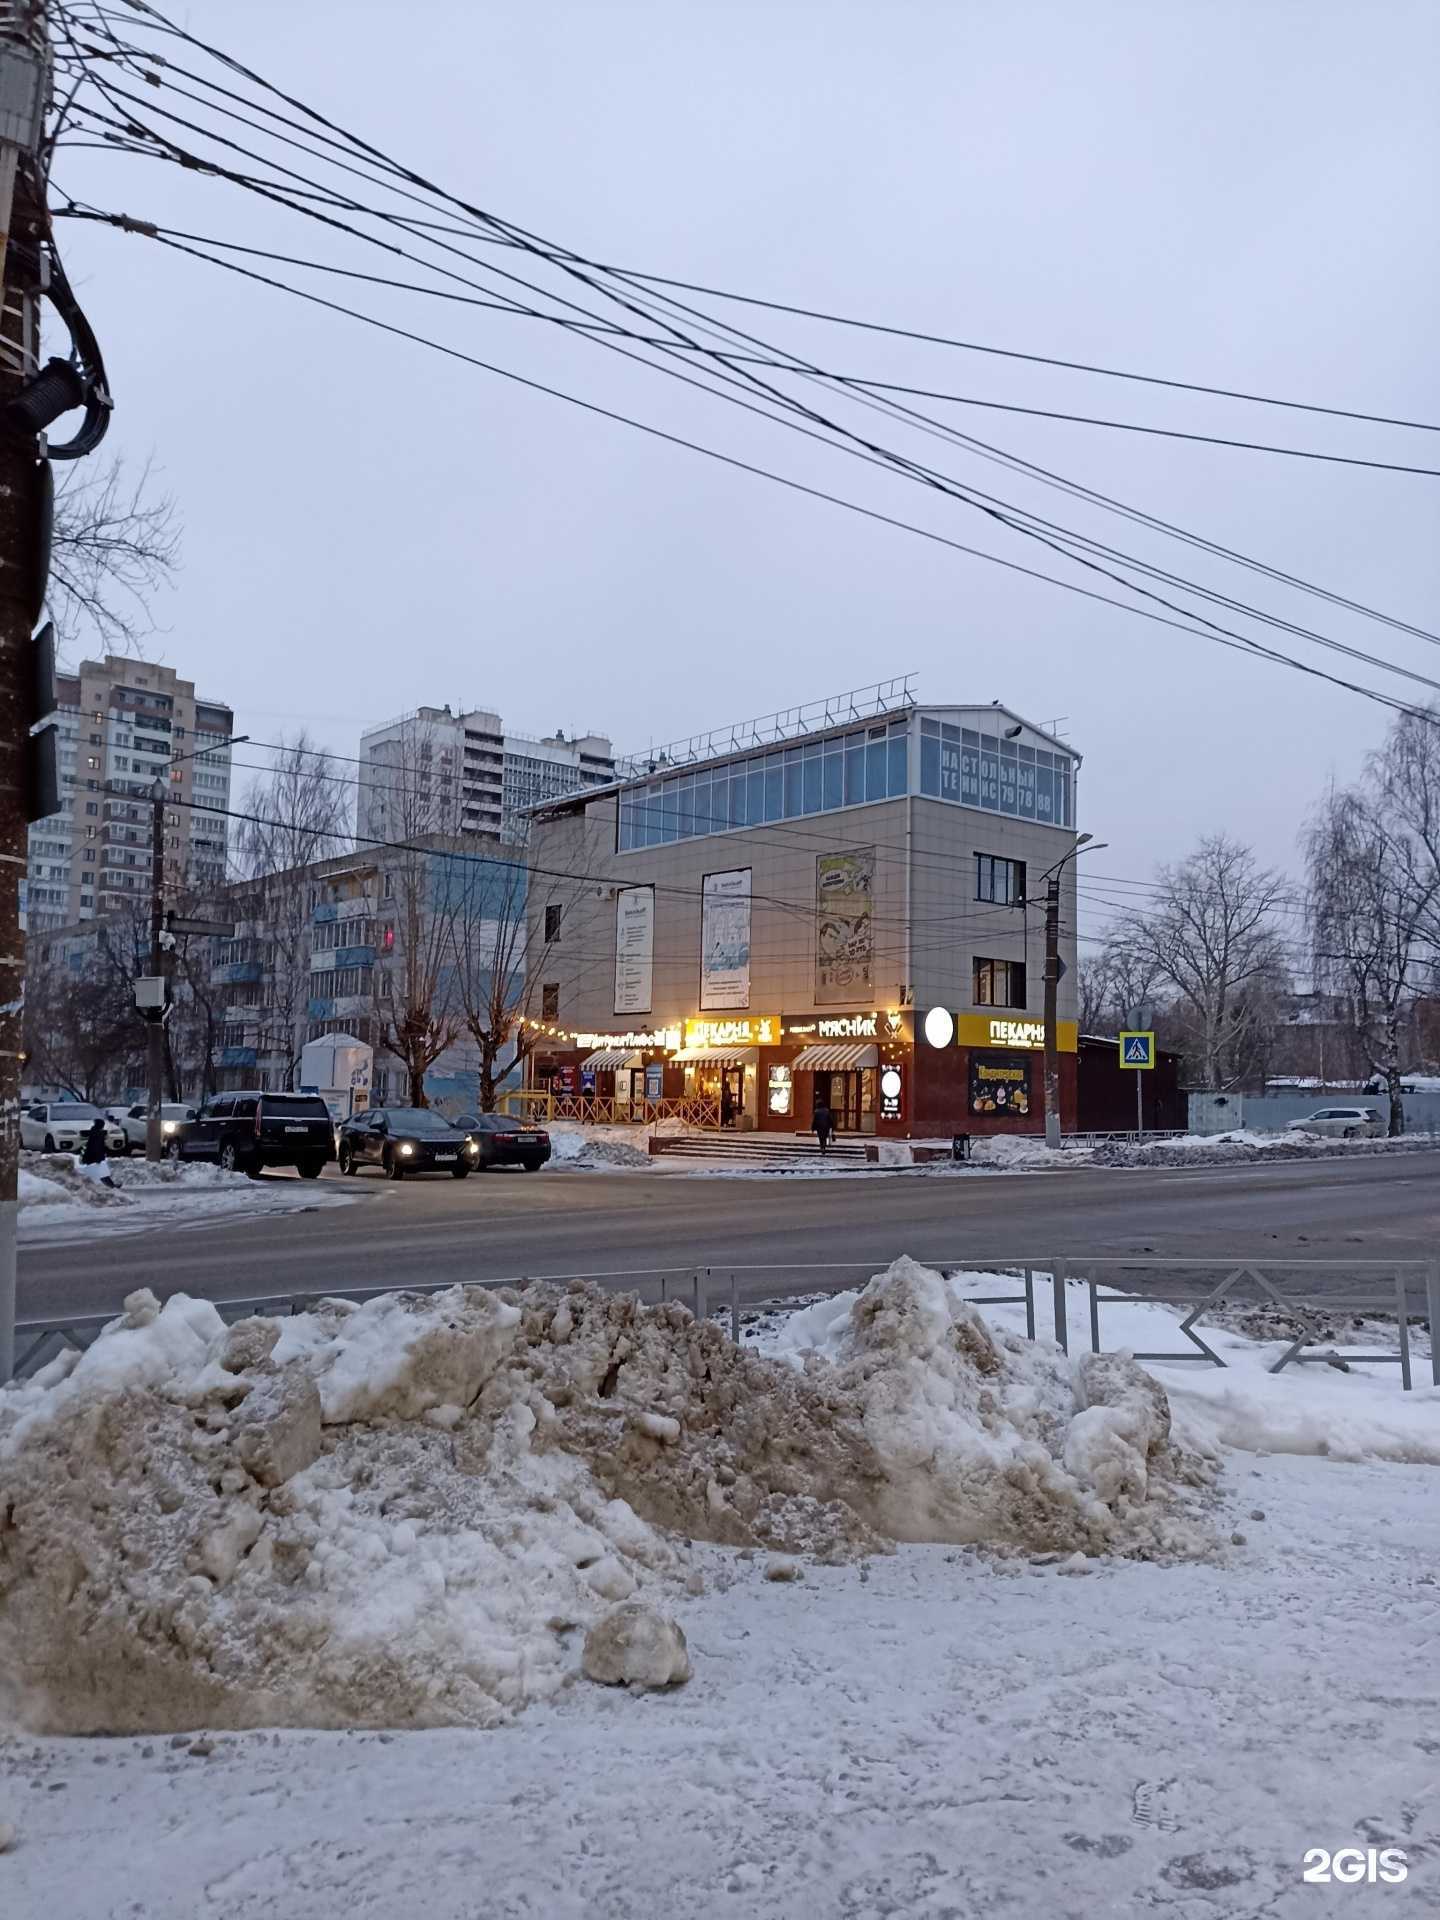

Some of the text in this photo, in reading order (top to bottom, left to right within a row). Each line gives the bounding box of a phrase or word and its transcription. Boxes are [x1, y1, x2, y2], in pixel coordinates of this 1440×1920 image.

[942, 750, 1035, 789] НАСТОЛЬНЫЙ
[942, 770, 997, 800] ТЕННИС
[1002, 785, 1015, 804] 79
[1019, 788, 1033, 808] 78
[818, 1019, 877, 1037] МЯСНИК
